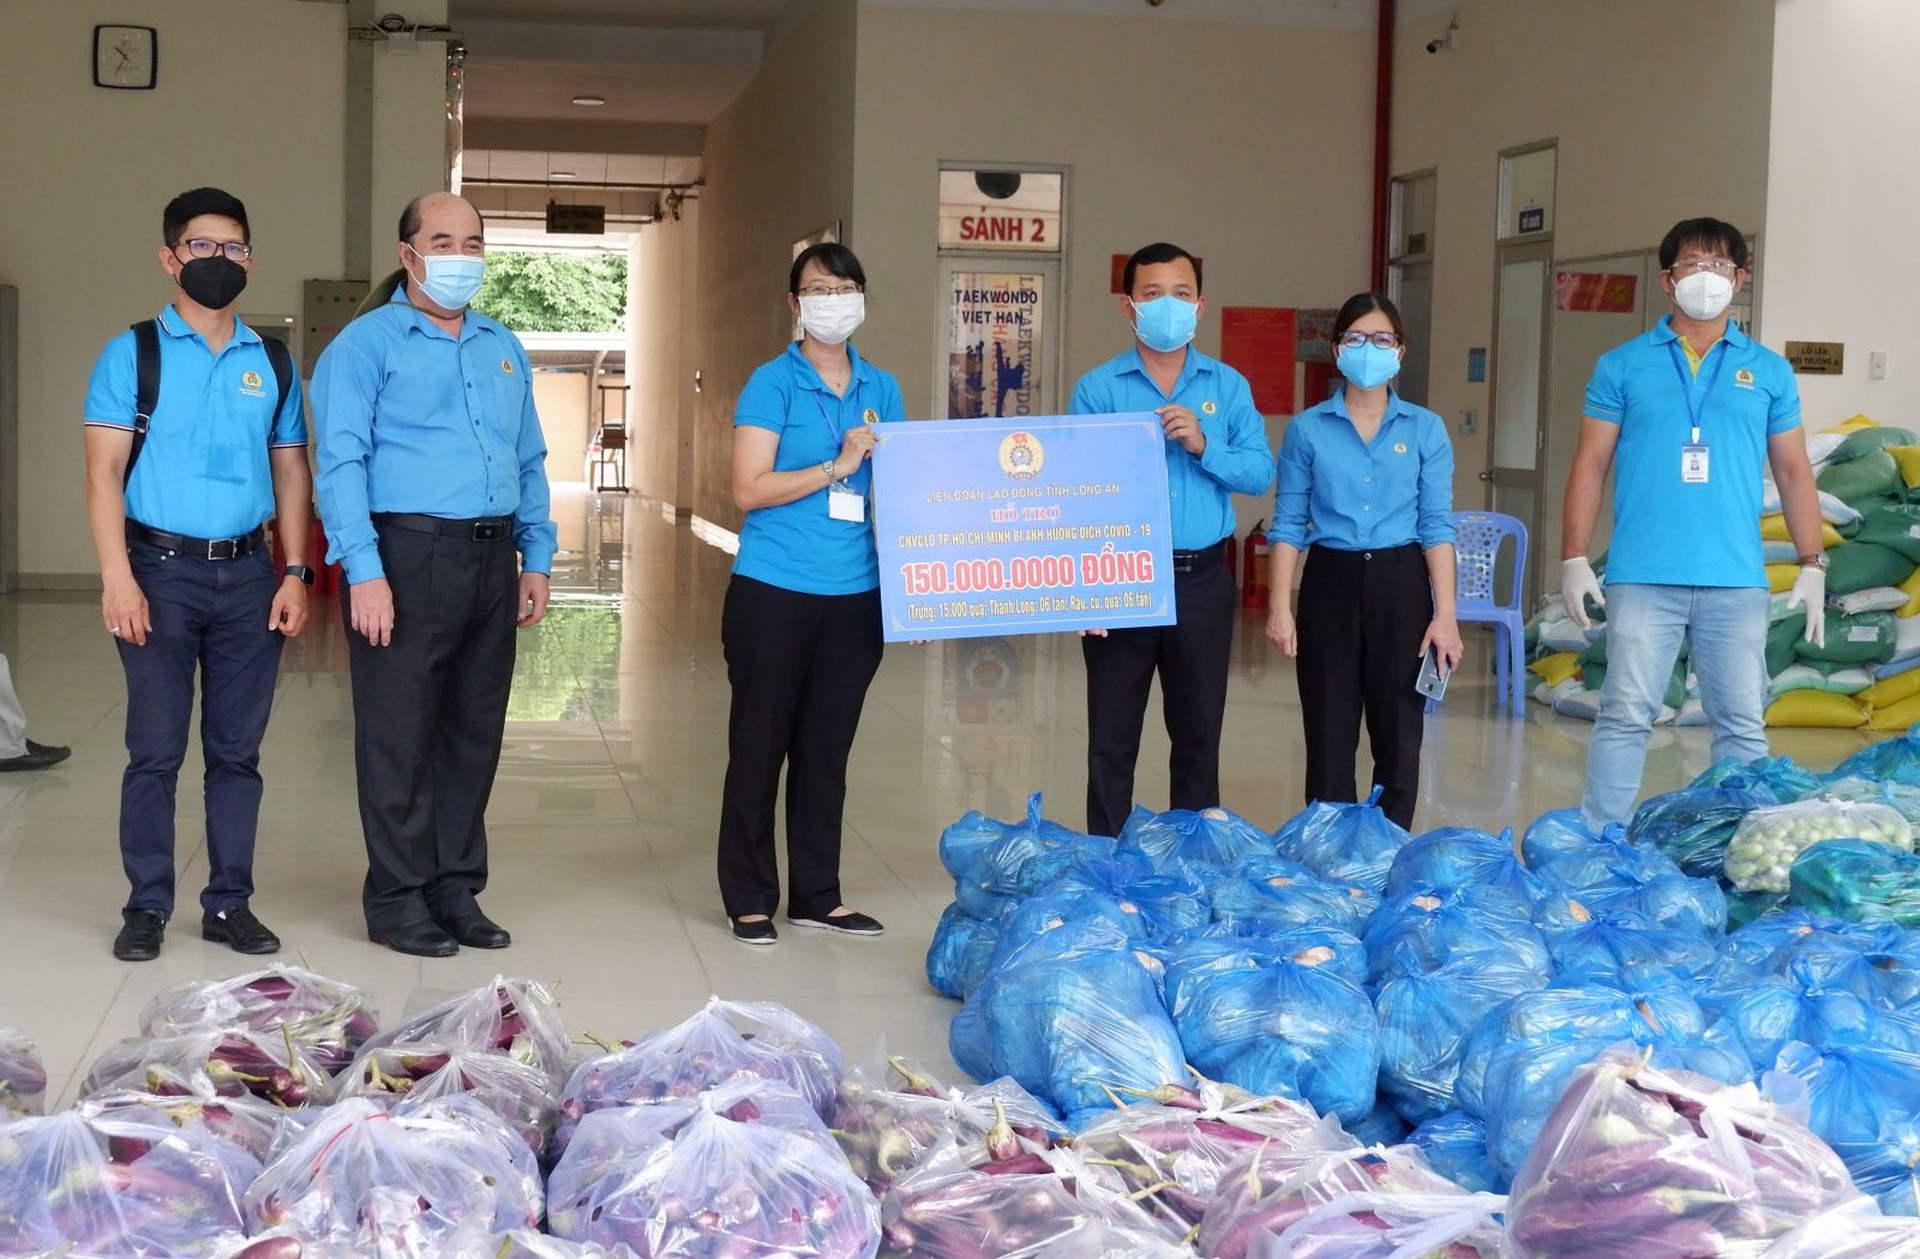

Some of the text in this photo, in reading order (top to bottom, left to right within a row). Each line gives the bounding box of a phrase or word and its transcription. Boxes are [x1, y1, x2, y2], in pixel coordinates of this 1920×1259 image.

[960, 205, 1045, 242] SẢNH 2
[955, 289, 1038, 304] TAEKWONDO
[988, 488, 1009, 499] LAO
[1073, 484, 1102, 496] LONG
[1104, 484, 1120, 495] AN
[1023, 504, 1061, 523] TRỢ
[987, 529, 1010, 544] MINH
[1103, 523, 1130, 538] COVID
[1140, 522, 1151, 537] 19
[901, 541, 1154, 595] 150.000.0000 ĐỒNG
[940, 602, 967, 618] 15.000
[989, 599, 1013, 616] Thanh
[1040, 596, 1049, 612] 06
[1123, 592, 1134, 607] 06
